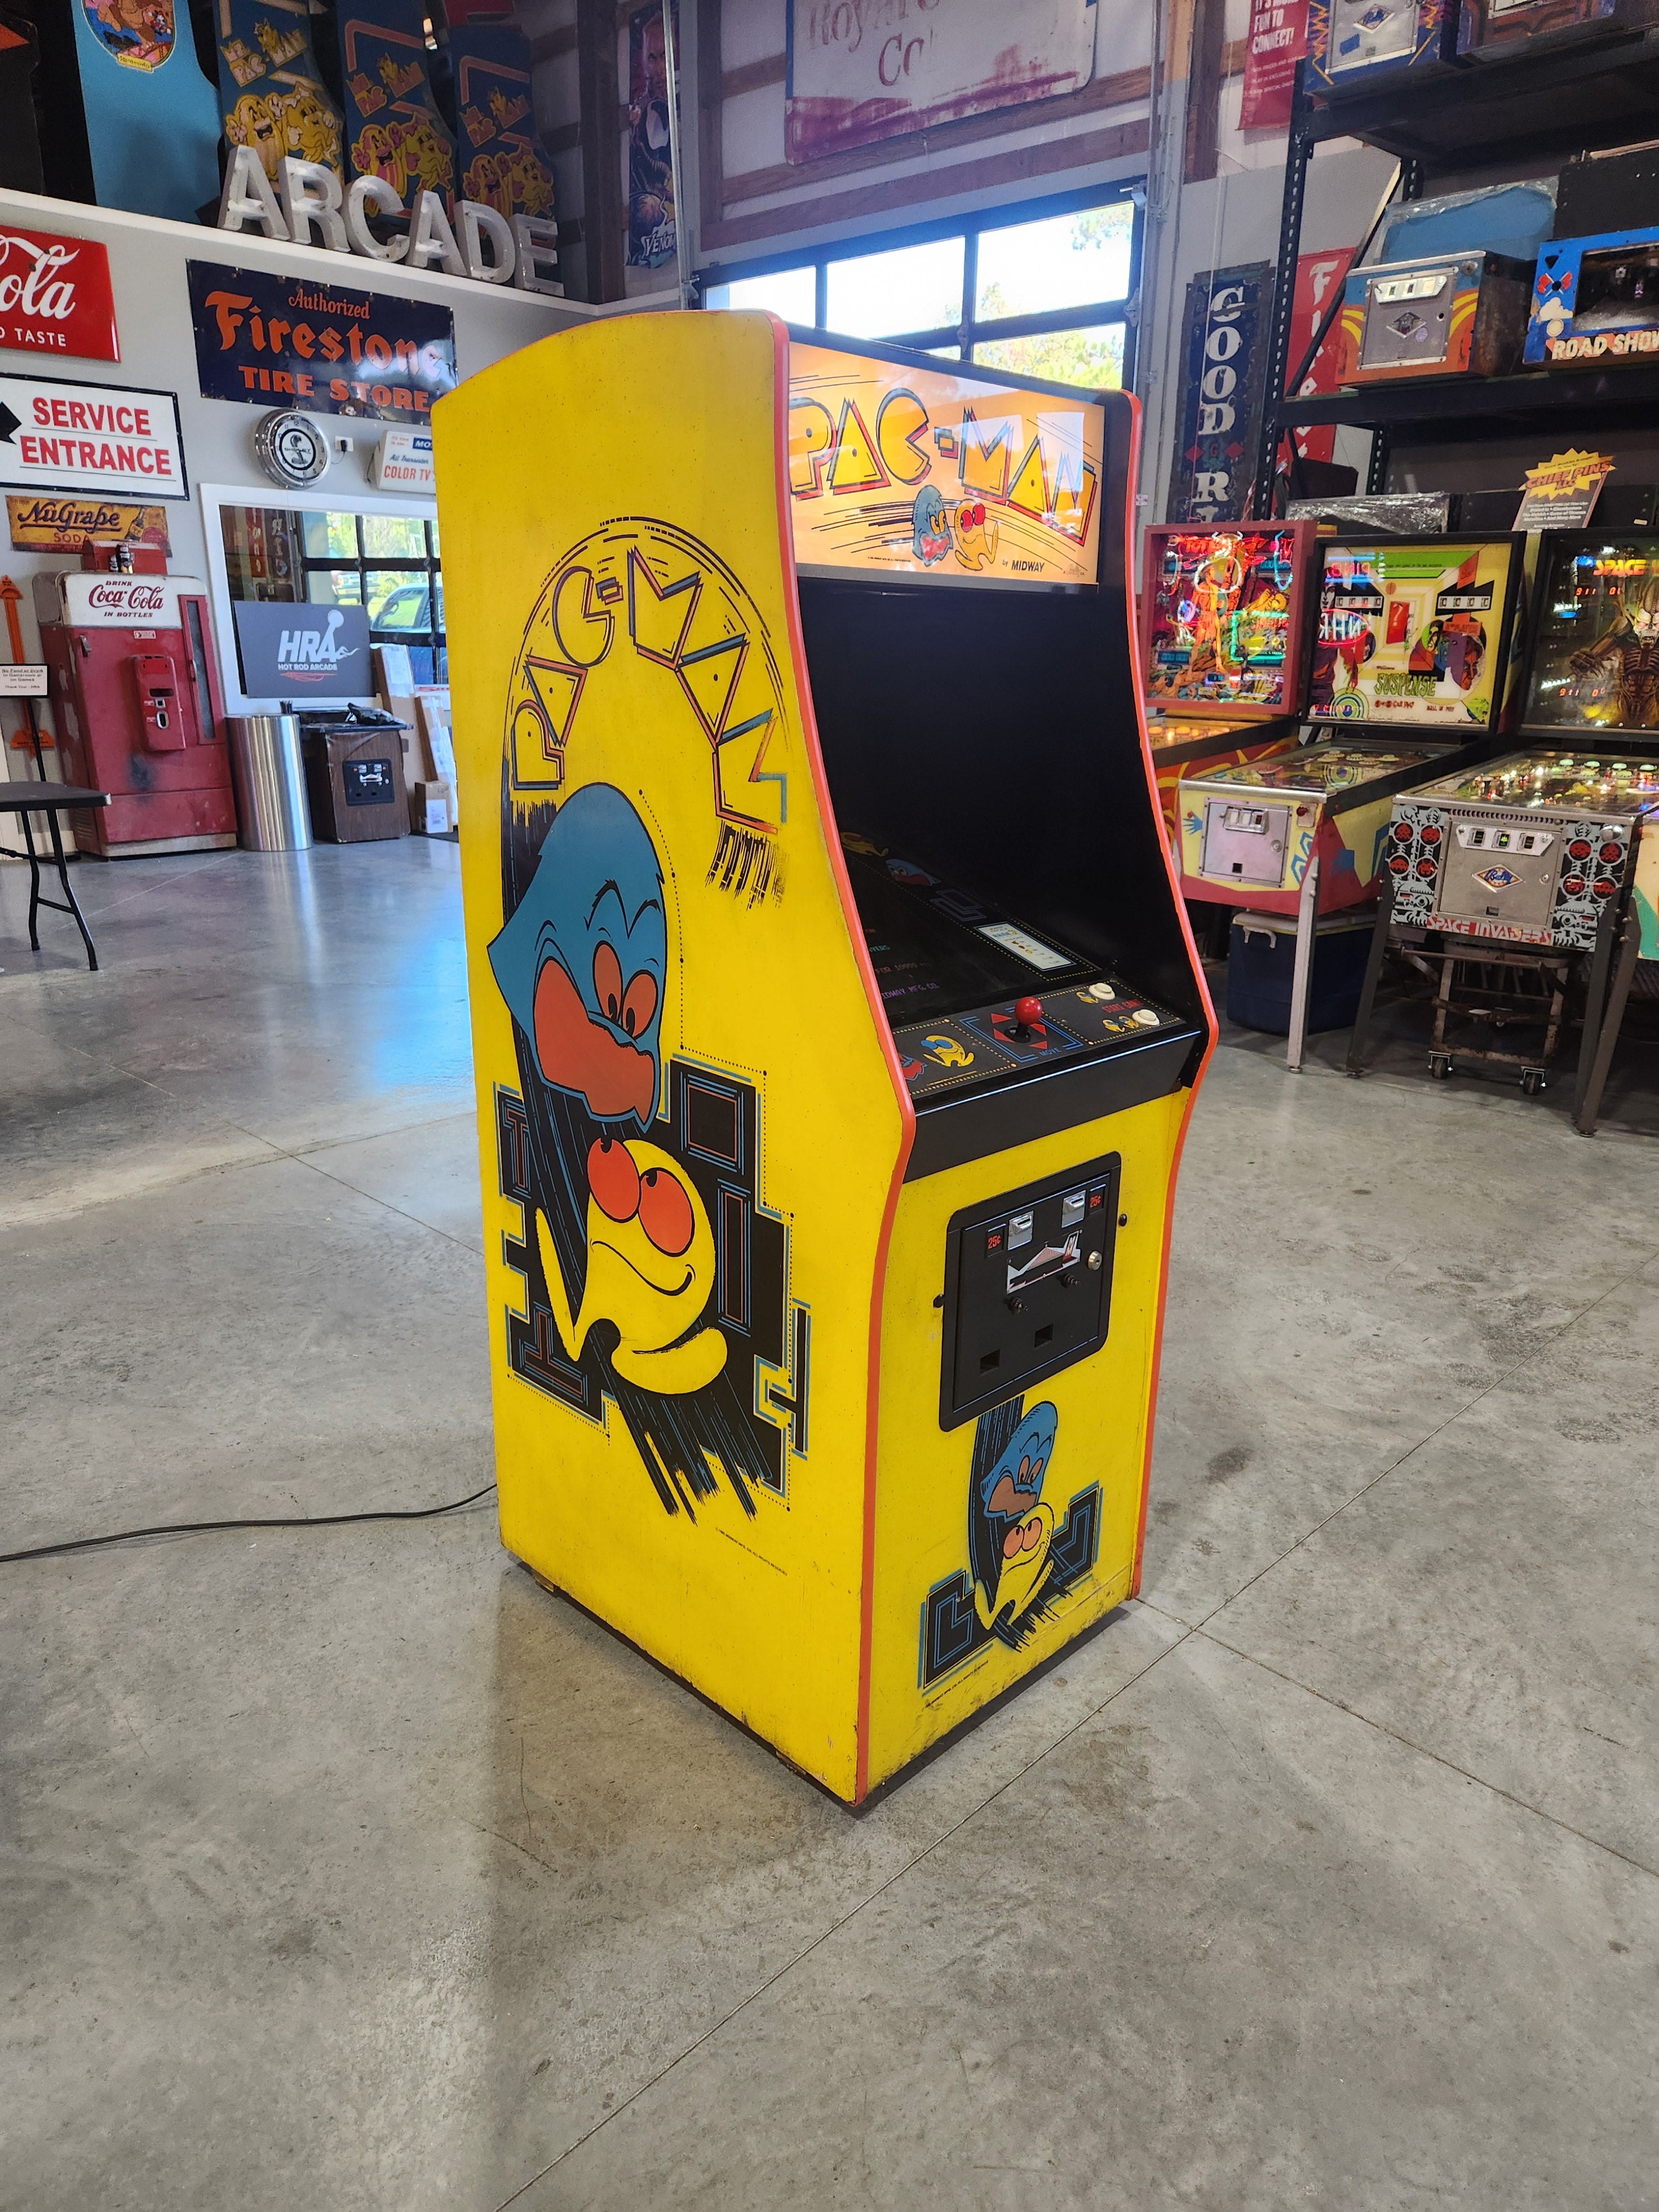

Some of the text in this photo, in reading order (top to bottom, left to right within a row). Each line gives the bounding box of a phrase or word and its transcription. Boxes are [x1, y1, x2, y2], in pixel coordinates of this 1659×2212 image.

[1254, 8, 1284, 33] FUN TO
[1252, 28, 1295, 54] CONNECT!
[217, 145, 564, 297] ARCADE
[0, 234, 80, 319] ola
[288, 289, 370, 320] Authorized
[14, 328, 66, 347] TASTE
[205, 291, 442, 378] Firestone
[1552, 336, 1608, 359] ROAD
[238, 366, 430, 412] TIRE STORE
[33, 397, 152, 436] SERVICE
[20, 435, 172, 476] ENTRANCE
[415, 440, 432, 448] MO
[384, 465, 431, 481] COLOR TV
[789, 388, 1097, 547] PAC-MAN
[1574, 461, 1611, 477] PINS
[17, 500, 121, 533] NuGrape
[53, 532, 89, 543] SODA
[1011, 560, 1045, 572] MIDWAY
[1593, 559, 1646, 576] SPACE
[88, 585, 165, 609] Coca-Cola
[278, 619, 338, 662] HRA
[511, 545, 787, 834] PAC-MAN
[1374, 672, 1437, 697] SUSPENSE
[1427, 915, 1552, 947] SPACE INVADERS
[1101, 1003, 1125, 1014] START
[1039, 1047, 1062, 1057] MOVE
[1089, 1194, 1102, 1208] 25¢
[987, 1234, 1001, 1250] 25¢
